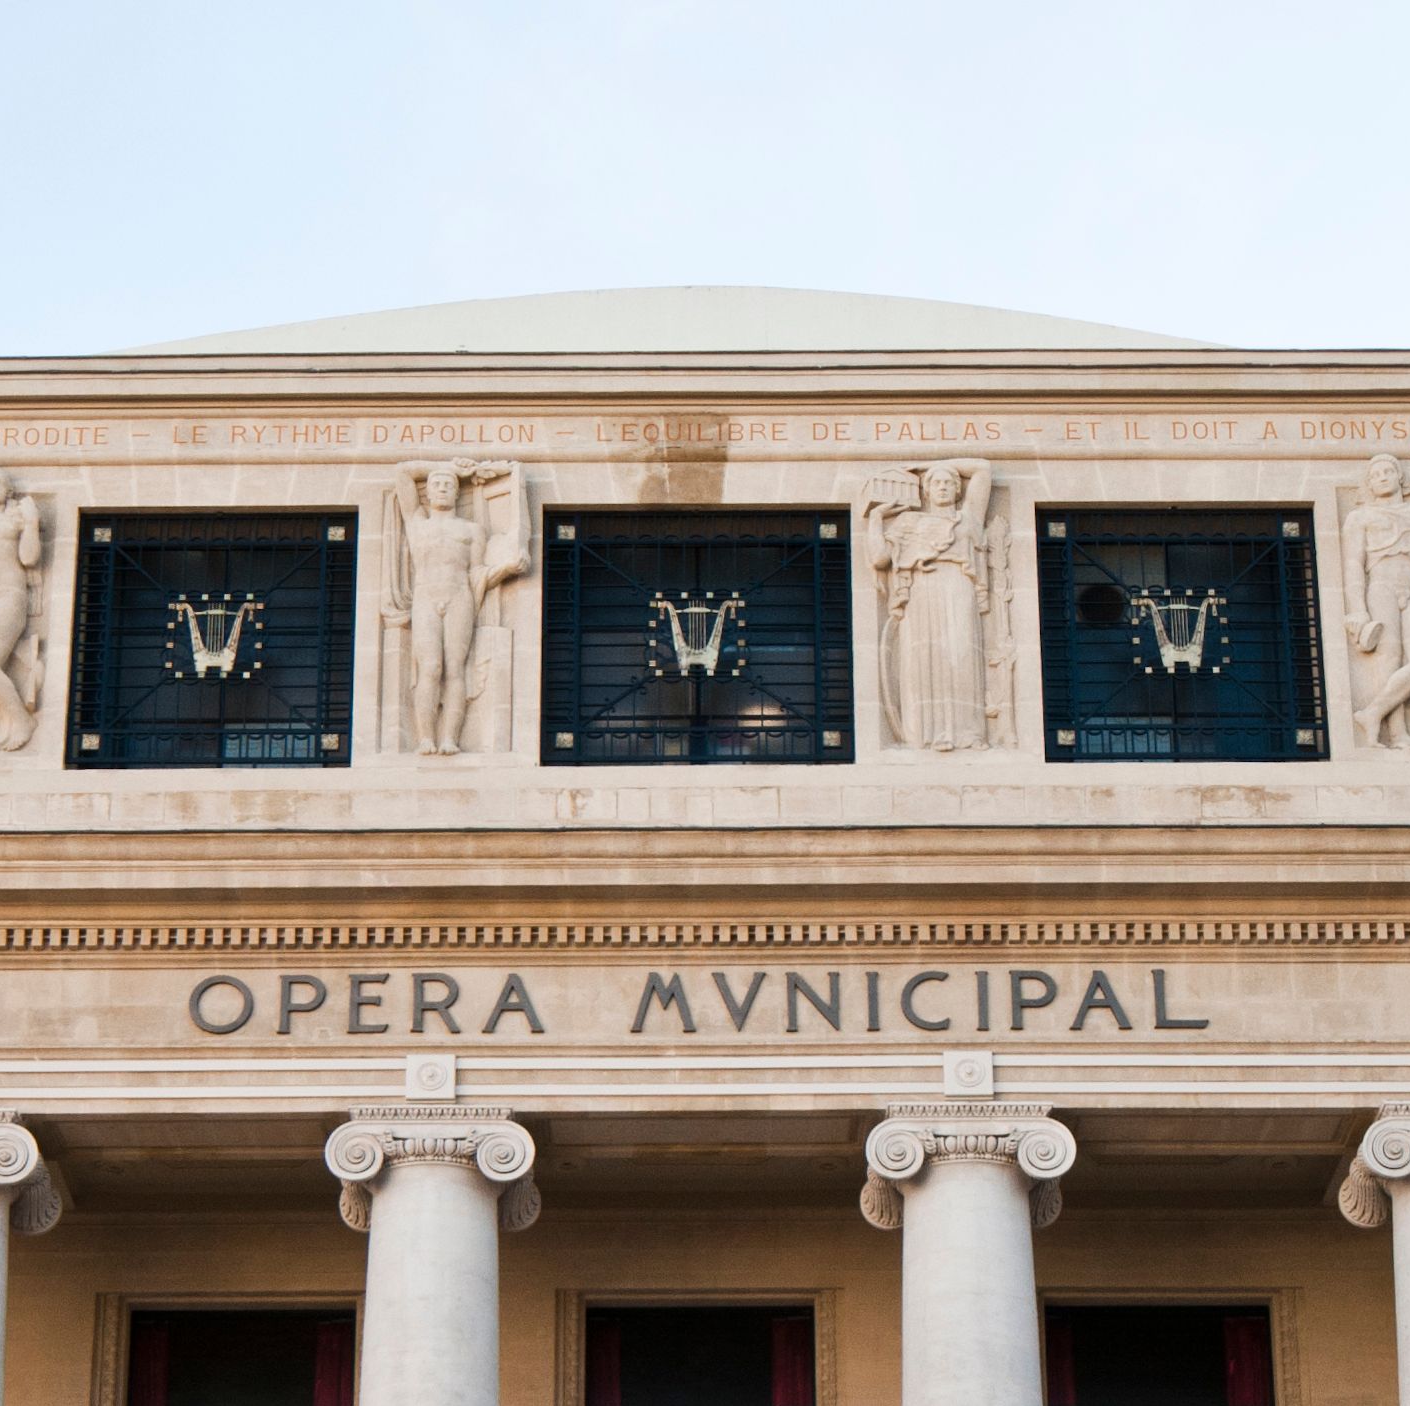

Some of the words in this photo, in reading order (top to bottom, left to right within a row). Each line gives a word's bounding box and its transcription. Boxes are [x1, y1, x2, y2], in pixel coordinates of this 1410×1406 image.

[172, 425, 209, 445] LE
[231, 425, 351, 444] RYTHME
[372, 424, 535, 443] D'APOLLON
[596, 422, 789, 443] L'EQUILIBRE
[812, 422, 852, 441] DE
[874, 421, 1002, 442] PALLAS
[1064, 421, 1102, 441] ET
[1123, 421, 1151, 440] IL
[1171, 420, 1239, 440] DOIT
[1262, 420, 1279, 440] A
[190, 972, 545, 1034] OPERA
[631, 968, 1210, 1033] MVNICIPAL
